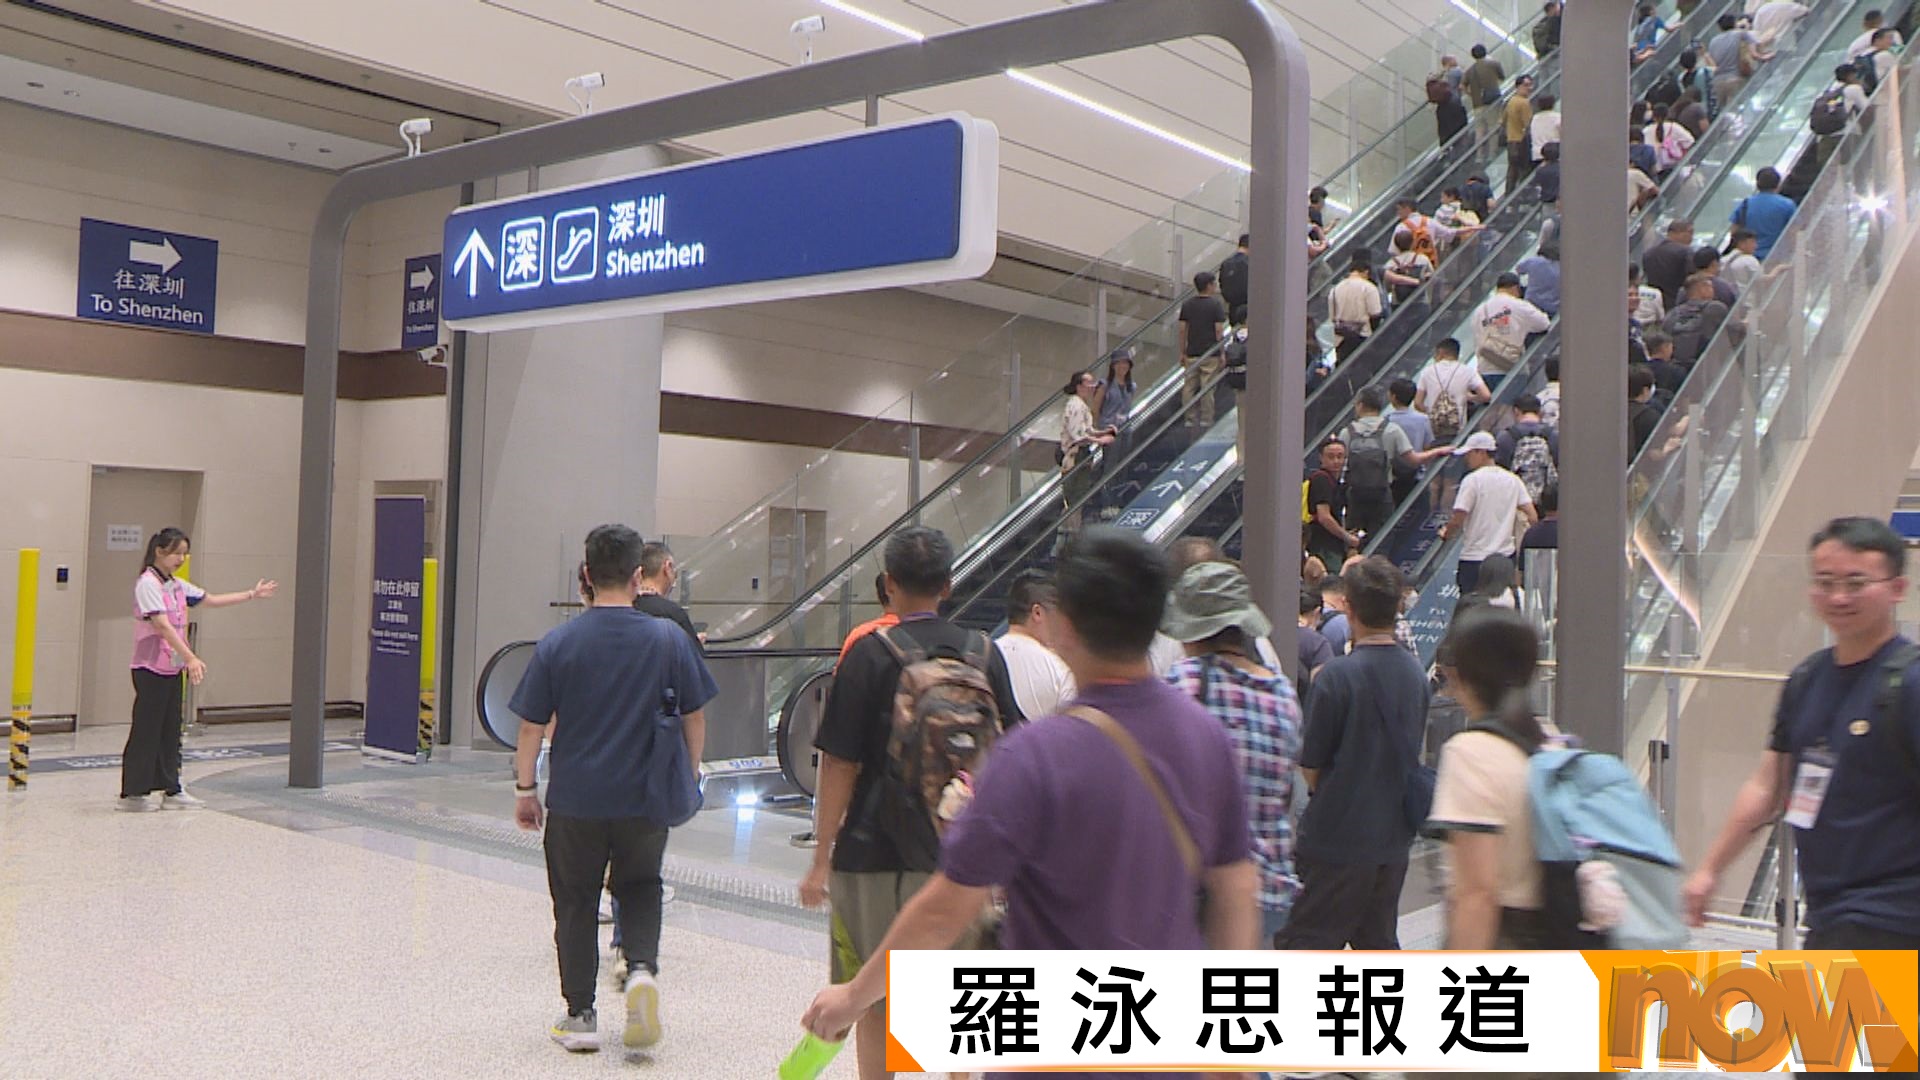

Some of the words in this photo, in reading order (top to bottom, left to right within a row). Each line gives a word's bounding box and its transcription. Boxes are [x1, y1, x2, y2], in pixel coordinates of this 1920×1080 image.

[608, 194, 666, 243] 深圳
[506, 228, 539, 280] 深
[606, 241, 705, 277] Shenzhen
[112, 268, 185, 300] 往深圳
[90, 293, 113, 312] To
[118, 297, 204, 325] Shenzhen
